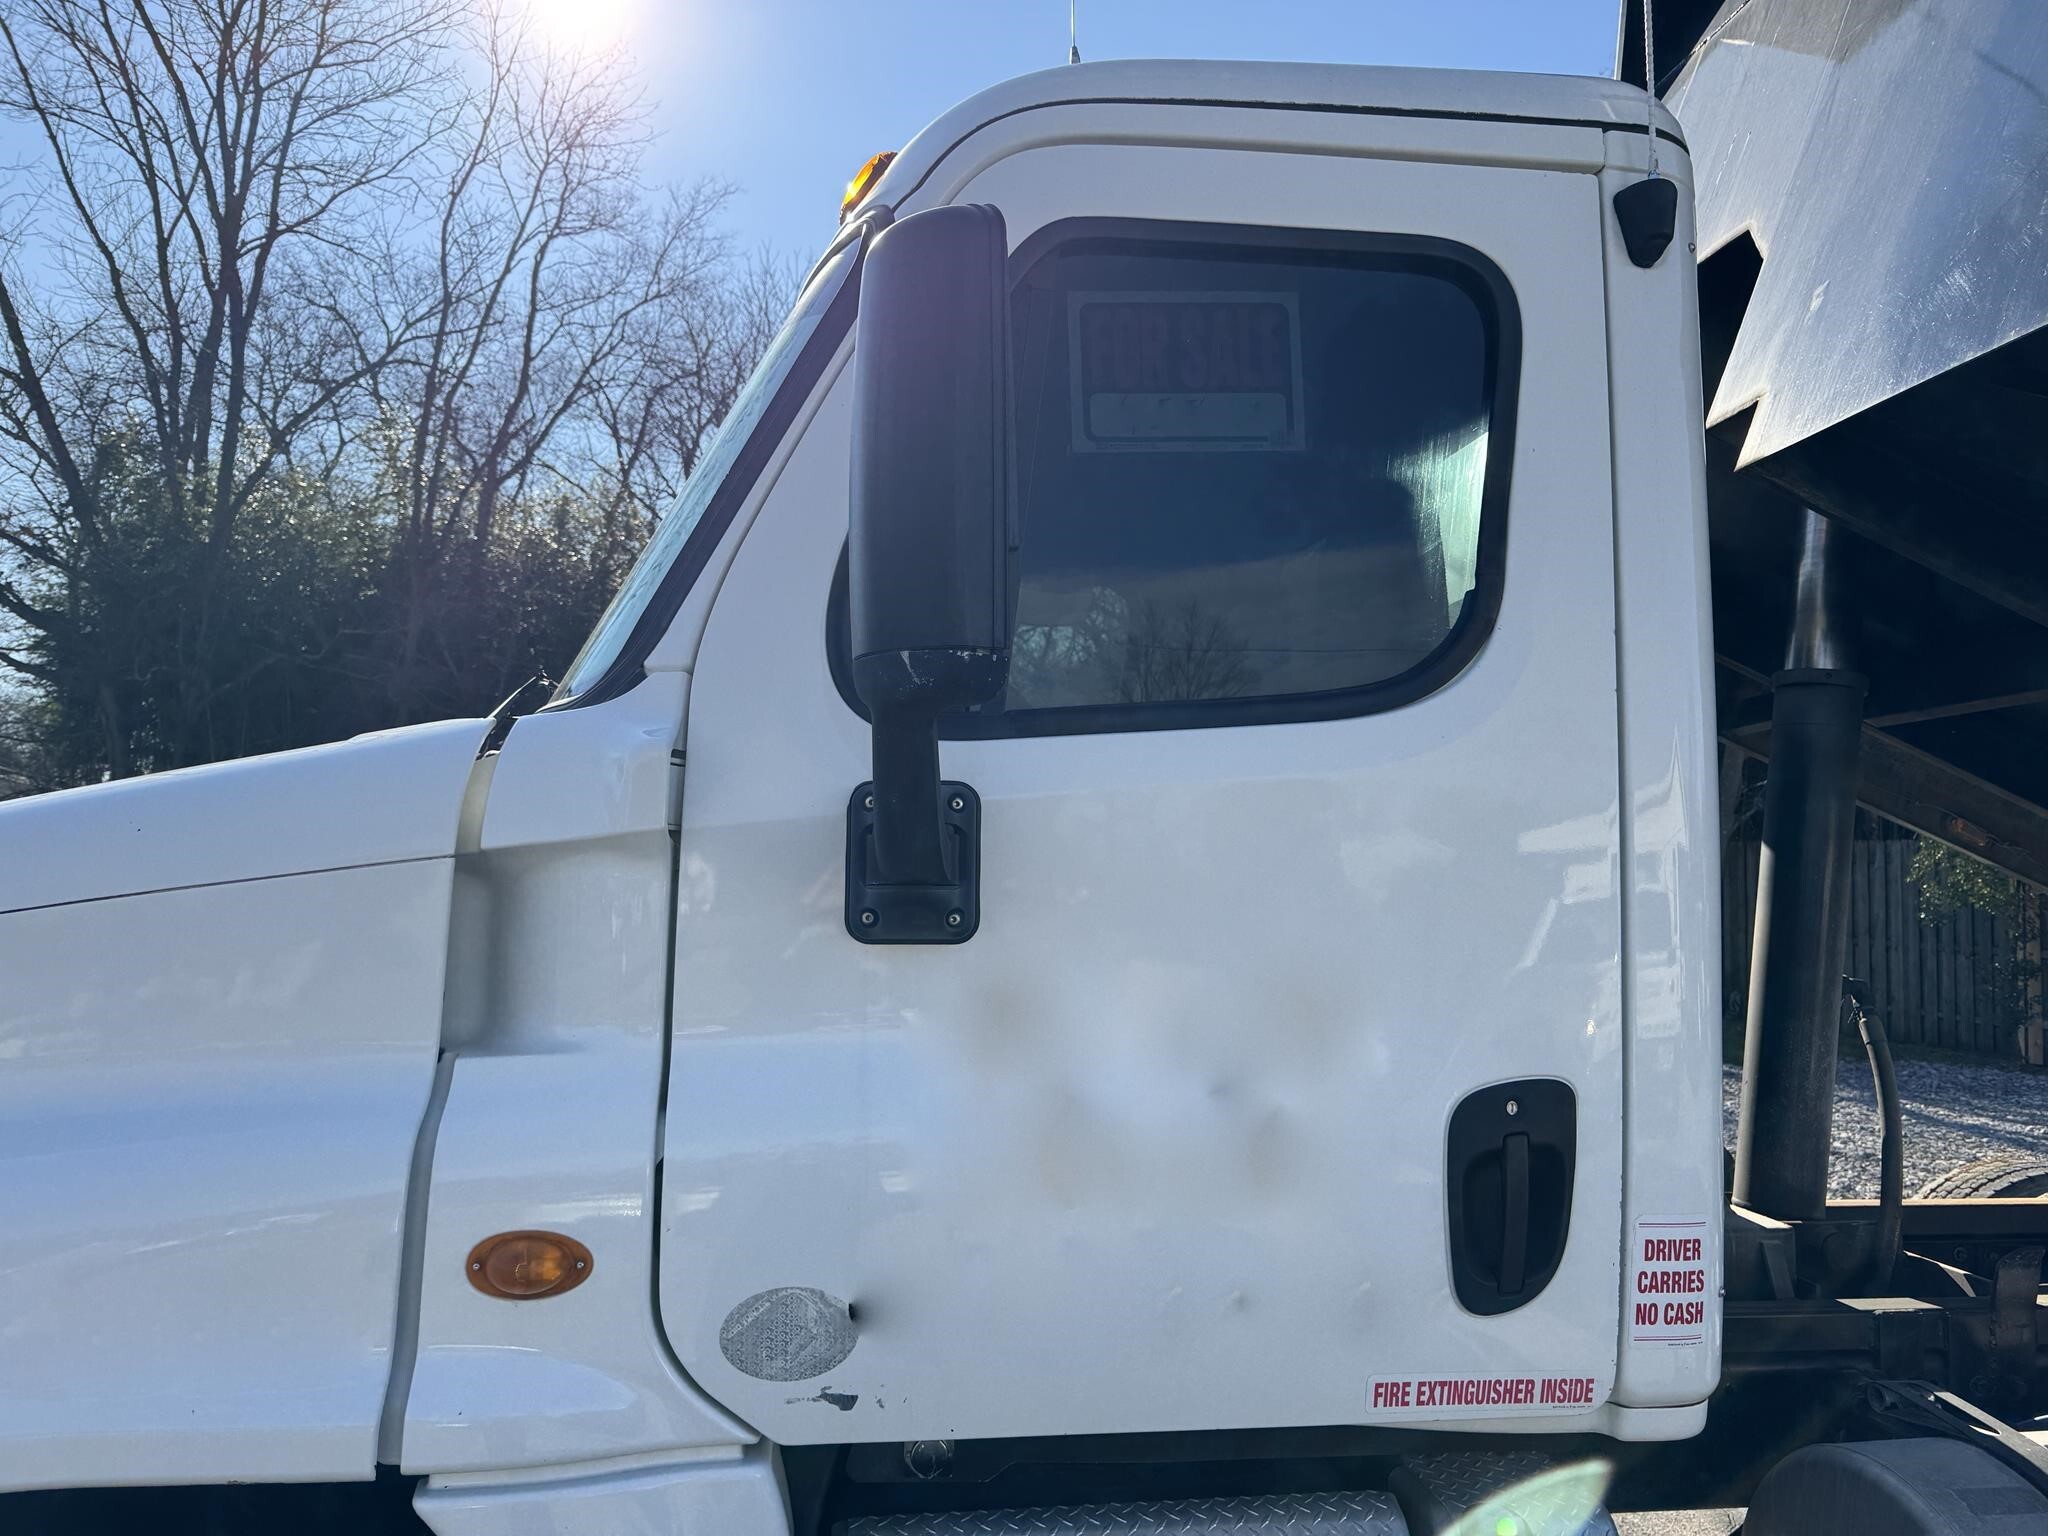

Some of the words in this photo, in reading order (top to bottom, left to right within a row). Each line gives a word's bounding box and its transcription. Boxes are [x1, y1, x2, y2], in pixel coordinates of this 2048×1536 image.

[1087, 306, 1168, 387] FOR
[1180, 305, 1285, 388] SALE
[1644, 1238, 1701, 1262] DRIVER
[1637, 1269, 1705, 1294] CARRIES
[1635, 1302, 1659, 1325] NO
[1663, 1301, 1704, 1325] CASH
[1373, 1381, 1412, 1408] FIRE
[1415, 1378, 1536, 1407] EXTINGUISHER
[1539, 1378, 1595, 1404] INSIDE
